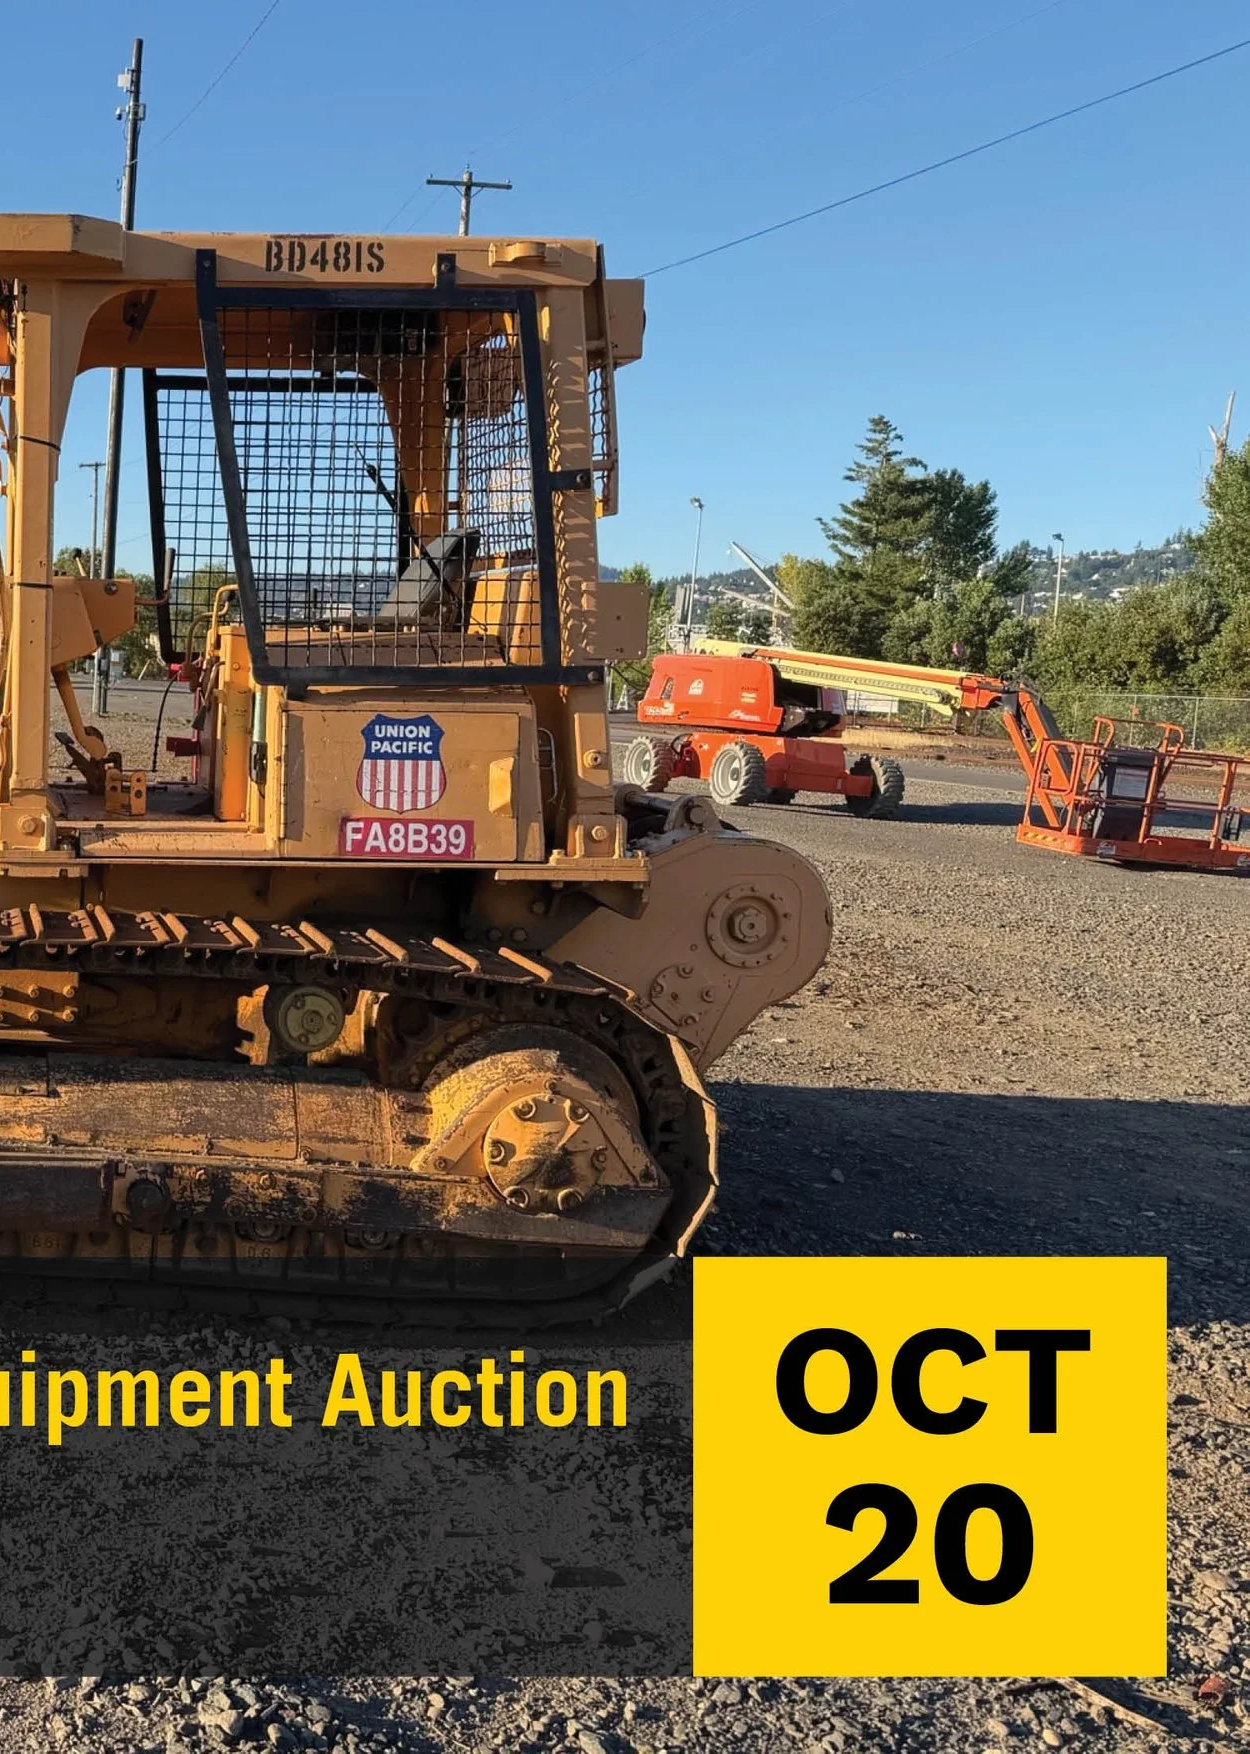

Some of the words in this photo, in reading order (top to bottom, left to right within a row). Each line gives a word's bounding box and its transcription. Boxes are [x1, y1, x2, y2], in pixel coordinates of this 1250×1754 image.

[374, 725, 431, 738] UNION
[371, 741, 433, 754] PACIFIC
[345, 821, 466, 854] FA8B39
